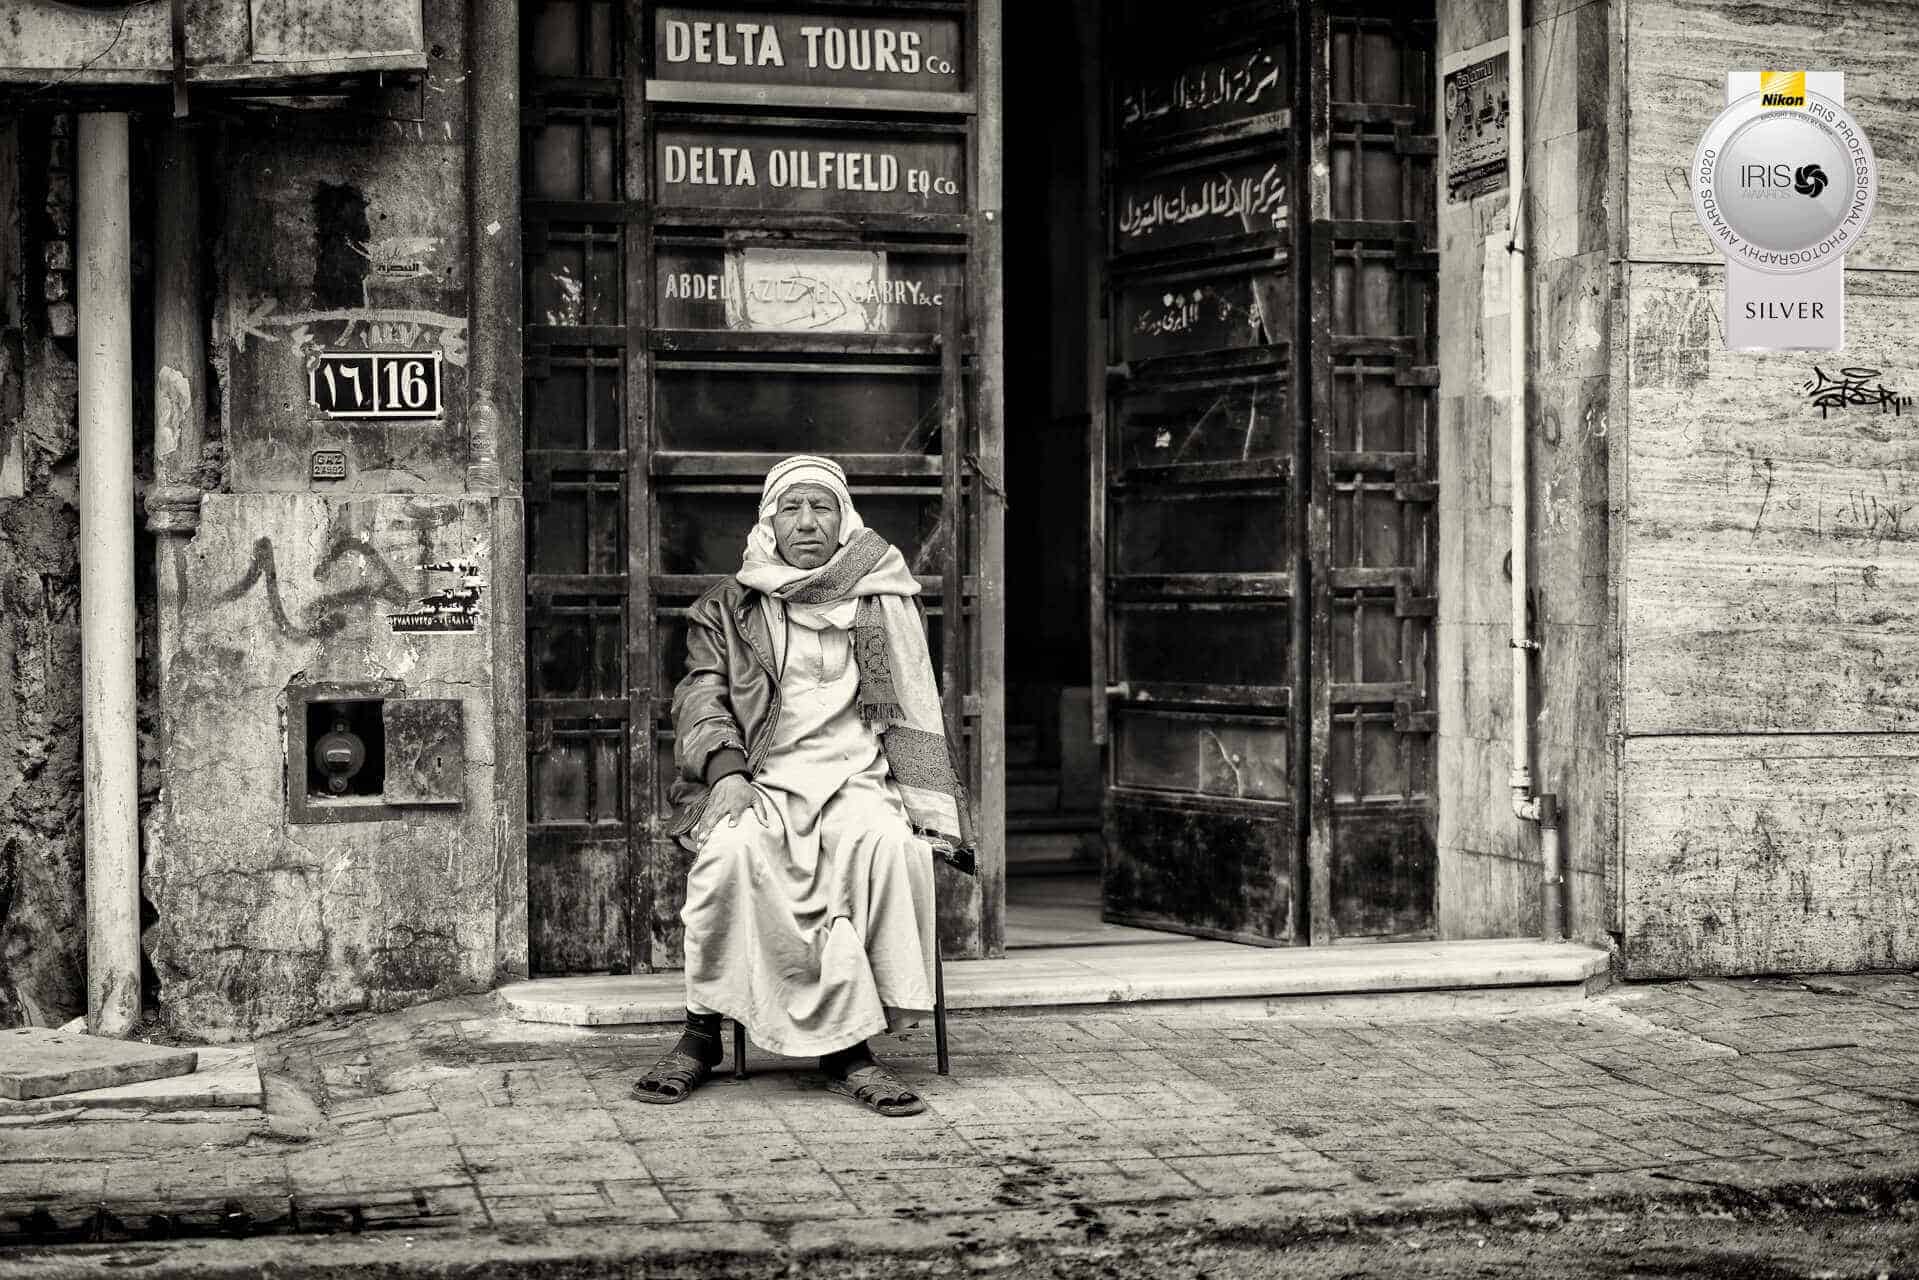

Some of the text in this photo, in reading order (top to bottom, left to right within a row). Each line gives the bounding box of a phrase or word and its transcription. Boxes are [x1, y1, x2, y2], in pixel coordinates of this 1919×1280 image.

[666, 20, 784, 66] DELTA
[801, 26, 921, 73] TOURS
[665, 146, 756, 186] DELTA
[768, 150, 898, 192] OILFIELD
[907, 169, 929, 199] EQ
[1250, 164, 1286, 216] شركة
[665, 273, 729, 300] ABDEL
[323, 362, 364, 408] ١٦
[384, 361, 428, 408] 16
[317, 455, 342, 465] GAZ
